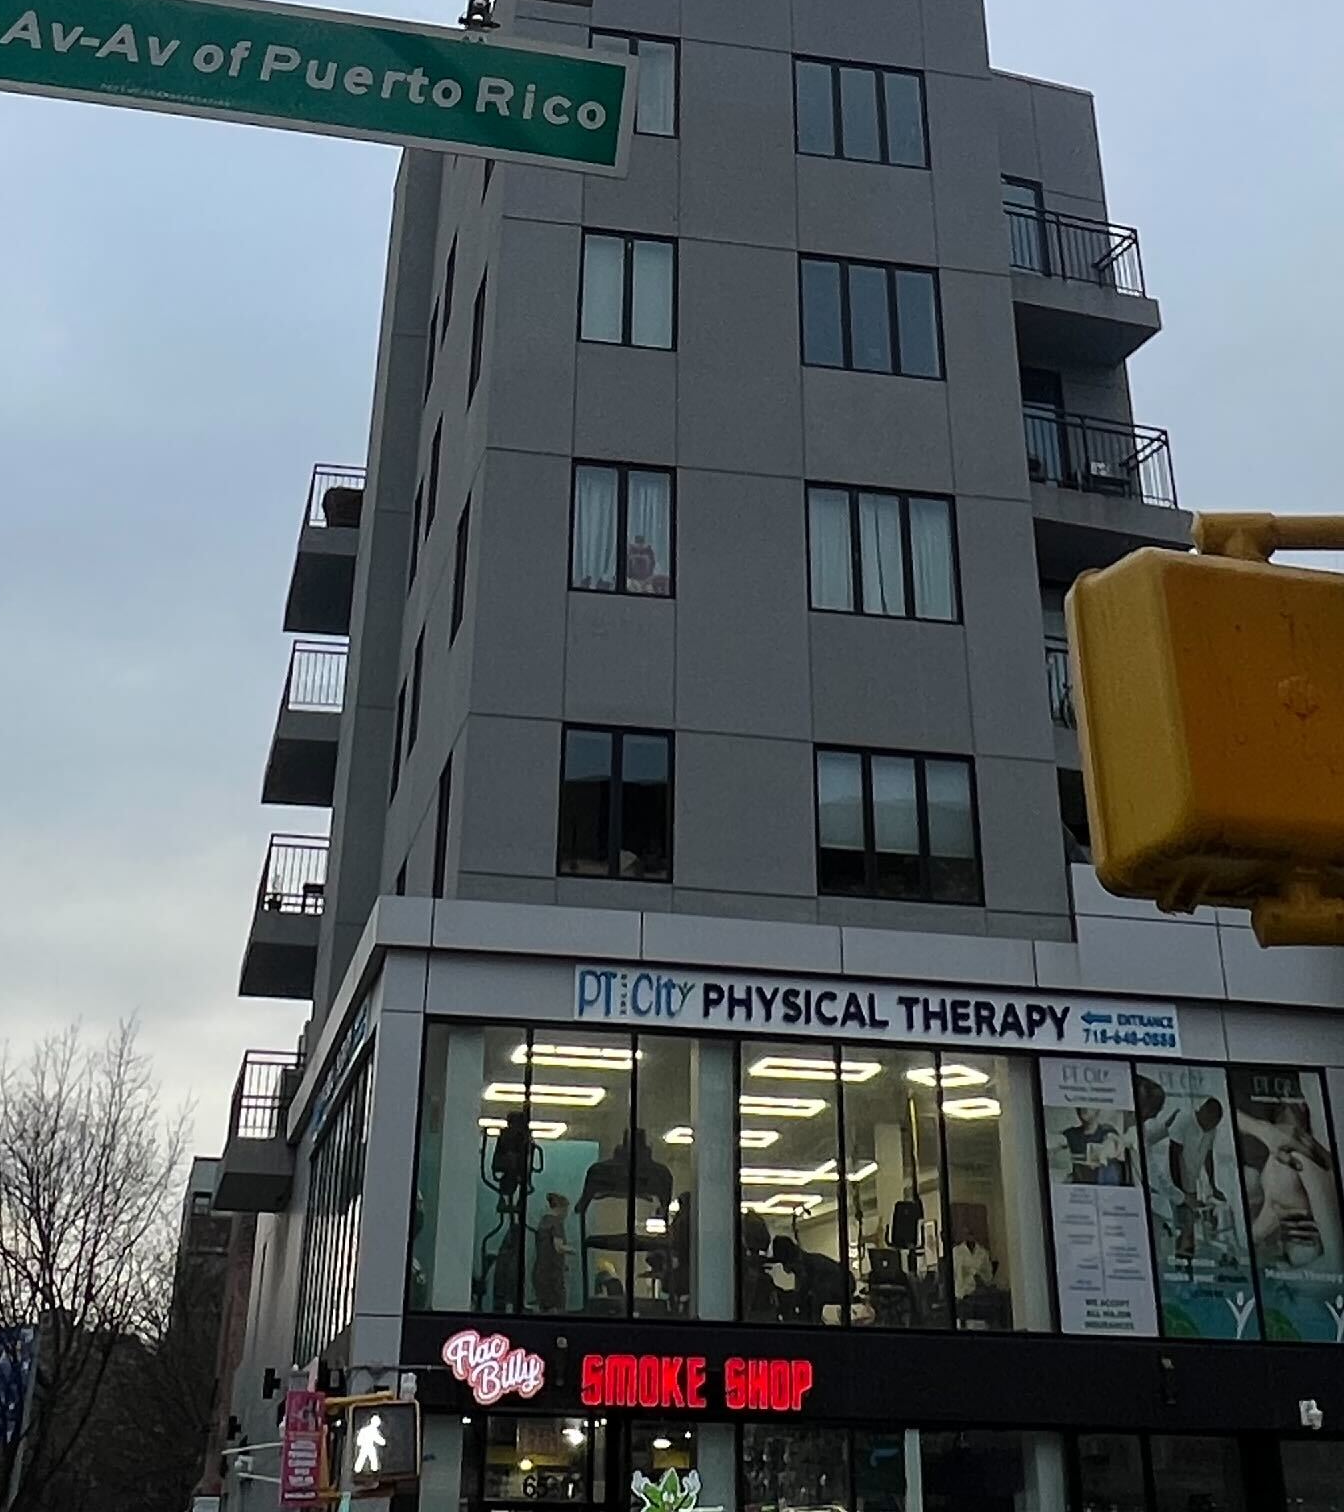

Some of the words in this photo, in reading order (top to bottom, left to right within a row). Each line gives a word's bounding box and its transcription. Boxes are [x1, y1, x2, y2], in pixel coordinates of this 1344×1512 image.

[192, 39, 251, 78] of
[259, 44, 464, 110] Puerto
[475, 74, 608, 130] Rico
[702, 982, 888, 1030] PHYSICAL
[897, 995, 1070, 1042] THERAPY
[471, 1349, 541, 1400] Billy
[581, 1354, 707, 1409] SMOKE
[724, 1357, 813, 1412] SHOP
